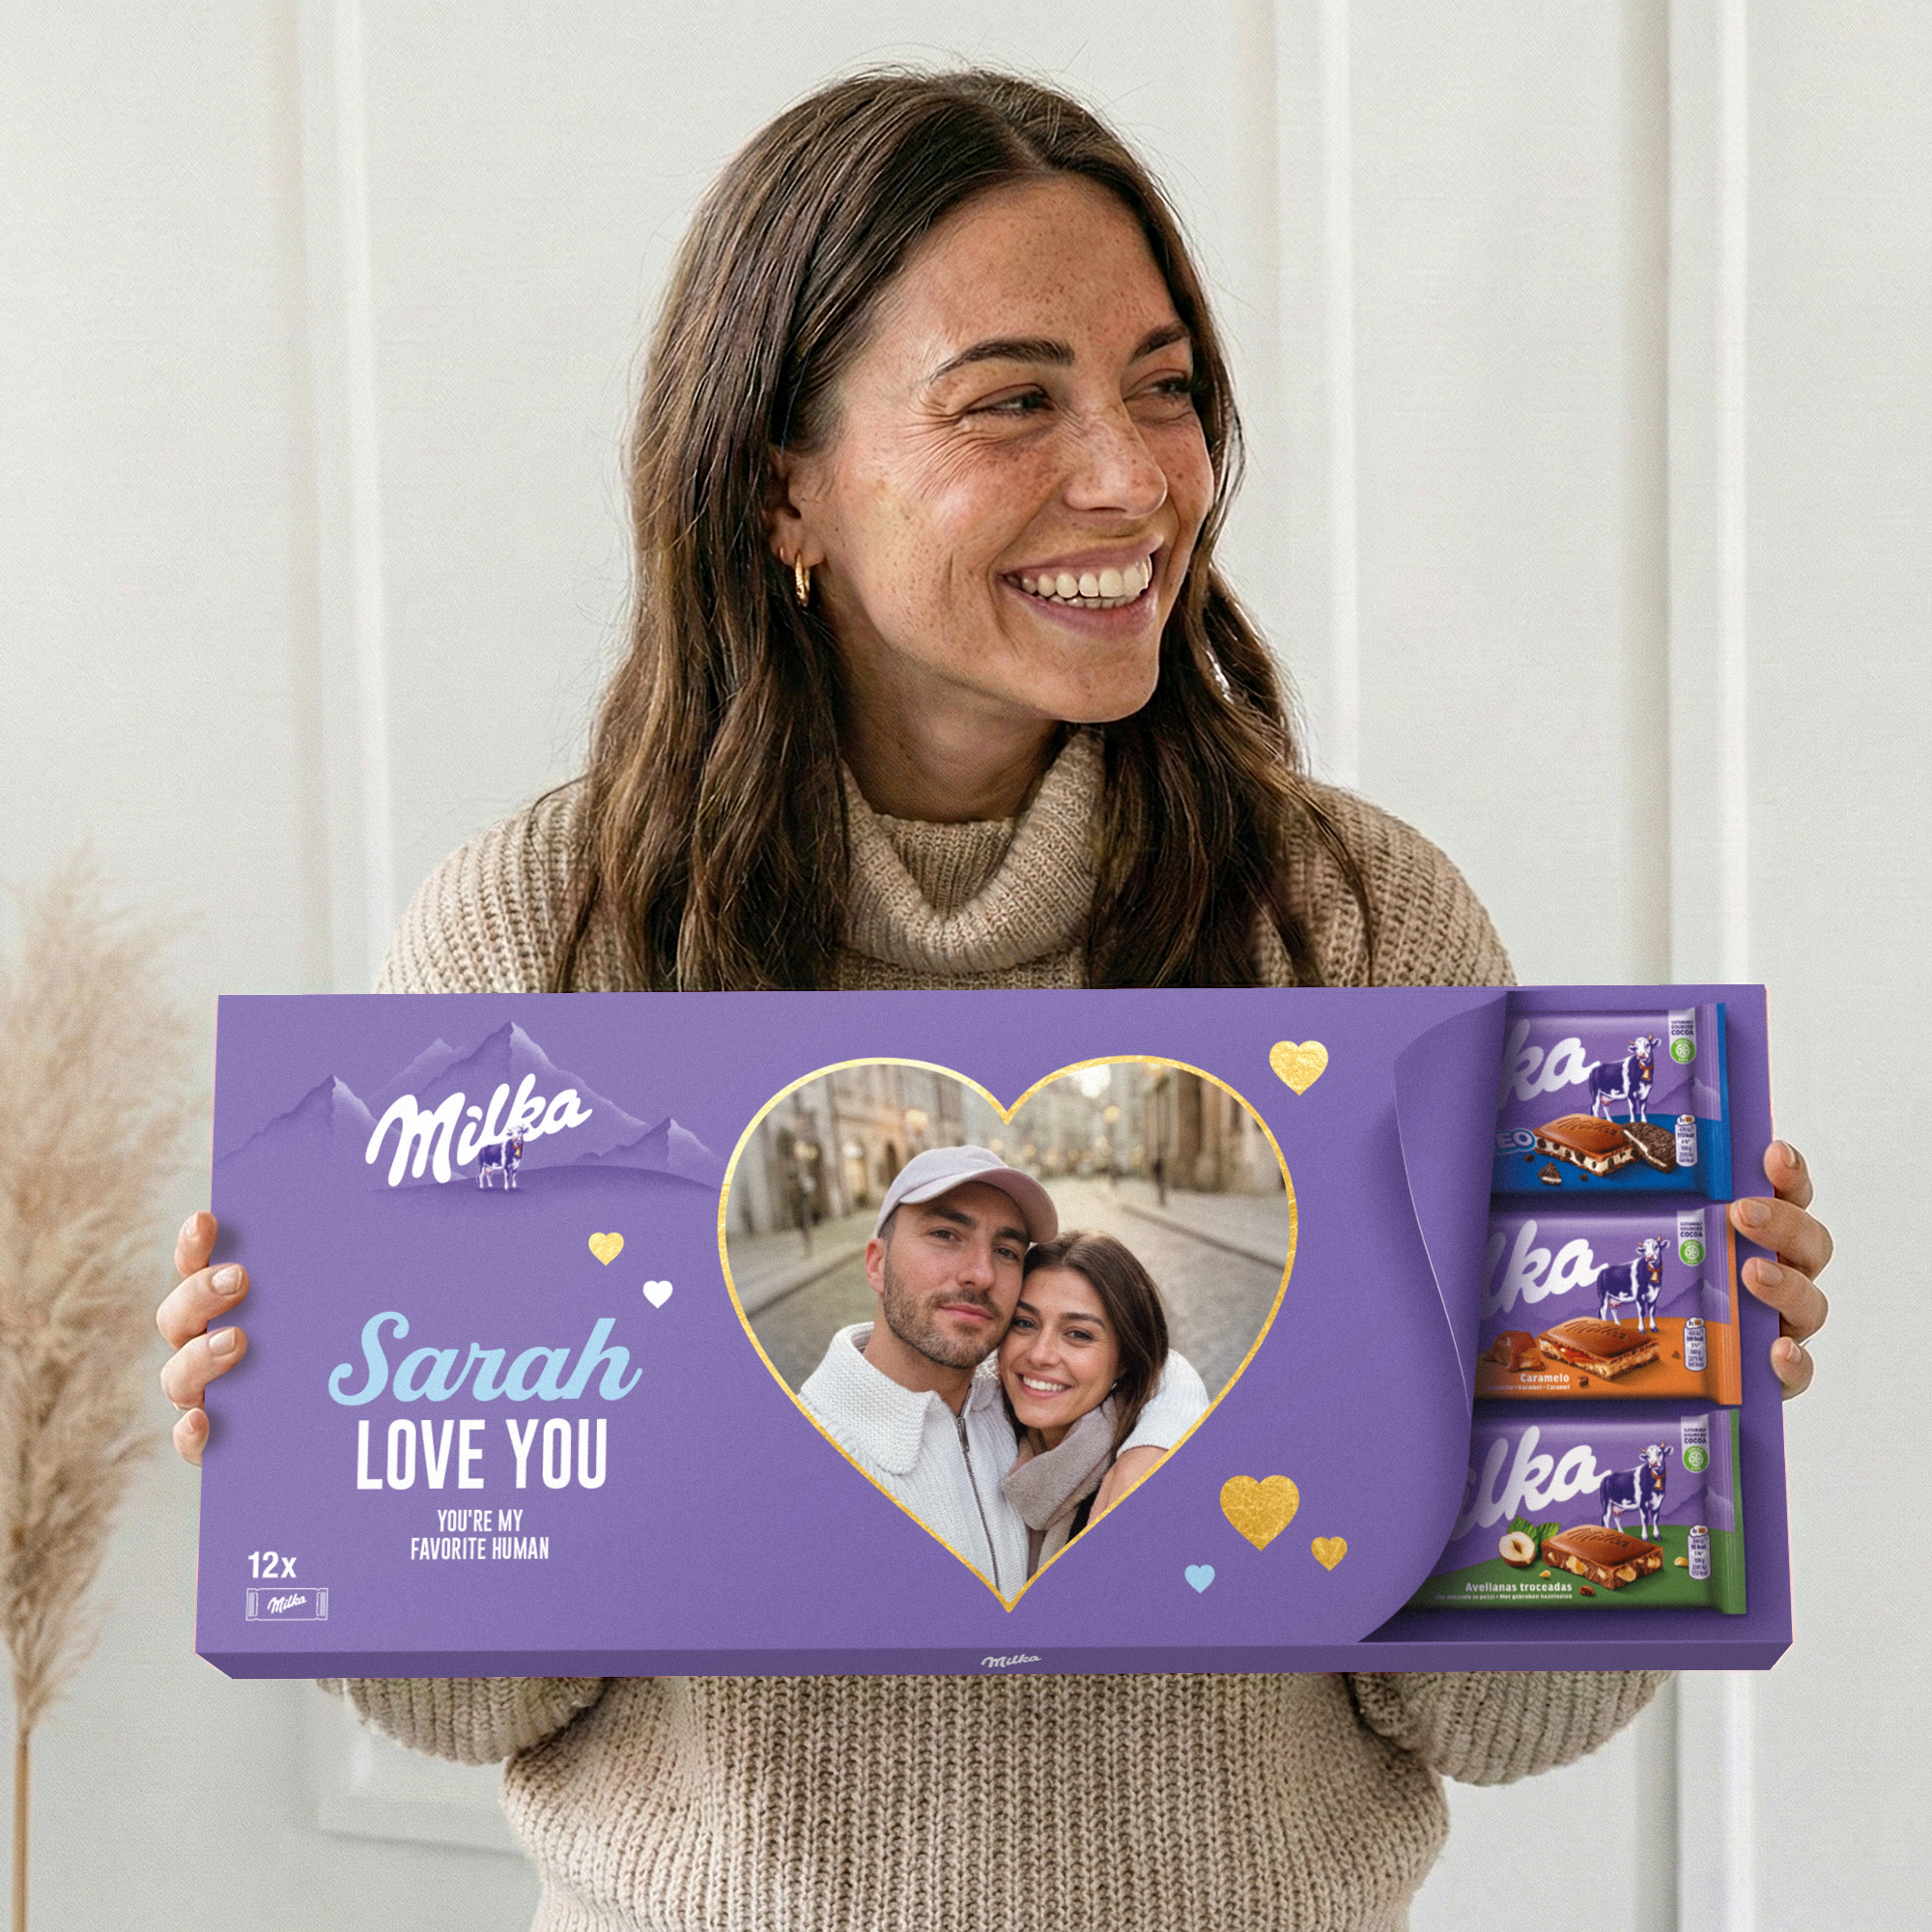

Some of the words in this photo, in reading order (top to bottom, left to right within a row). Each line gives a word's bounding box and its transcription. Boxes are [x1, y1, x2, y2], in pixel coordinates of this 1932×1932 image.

[365, 1073, 593, 1187] Milka
[328, 1311, 642, 1406] Sarah
[1520, 1373, 1570, 1383] Caramelo
[355, 1419, 486, 1491] LOVE
[505, 1418, 608, 1490] YOU
[438, 1510, 493, 1533] YOU'RE
[498, 1509, 525, 1532] MY
[411, 1537, 487, 1561] FAVORITE
[493, 1536, 550, 1560] HUMAN
[248, 1550, 298, 1578] 12x
[1465, 1582, 1518, 1592] Avellanas
[1520, 1581, 1573, 1592] troceadas
[267, 1593, 307, 1614] Milka
[980, 1654, 1041, 1668] Milka
